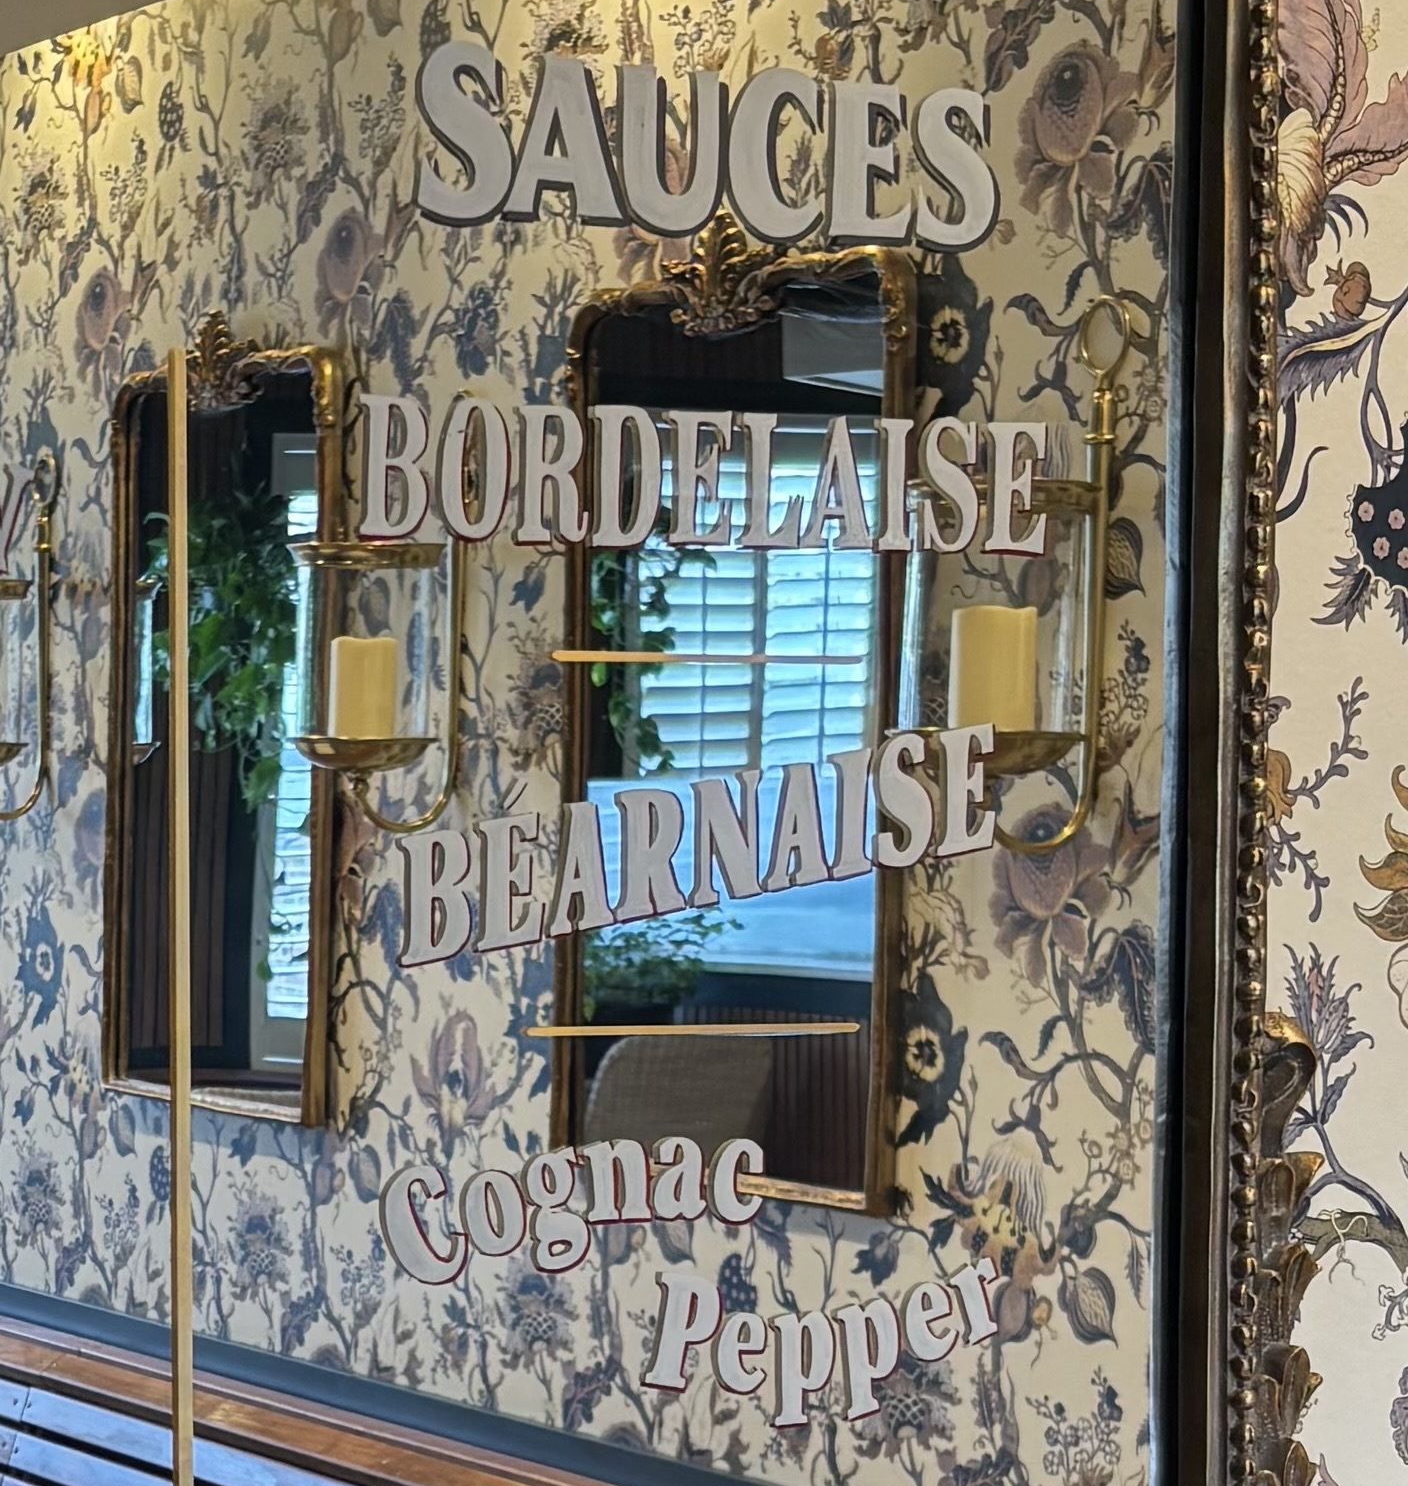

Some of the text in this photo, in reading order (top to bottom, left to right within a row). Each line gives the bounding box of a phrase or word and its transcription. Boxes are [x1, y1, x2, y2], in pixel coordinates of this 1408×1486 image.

[415, 41, 1001, 252] SAUCES
[358, 393, 1048, 557] BORDELAISE
[379, 1137, 766, 1286] Cognac
[639, 1257, 999, 1428] Pepper
